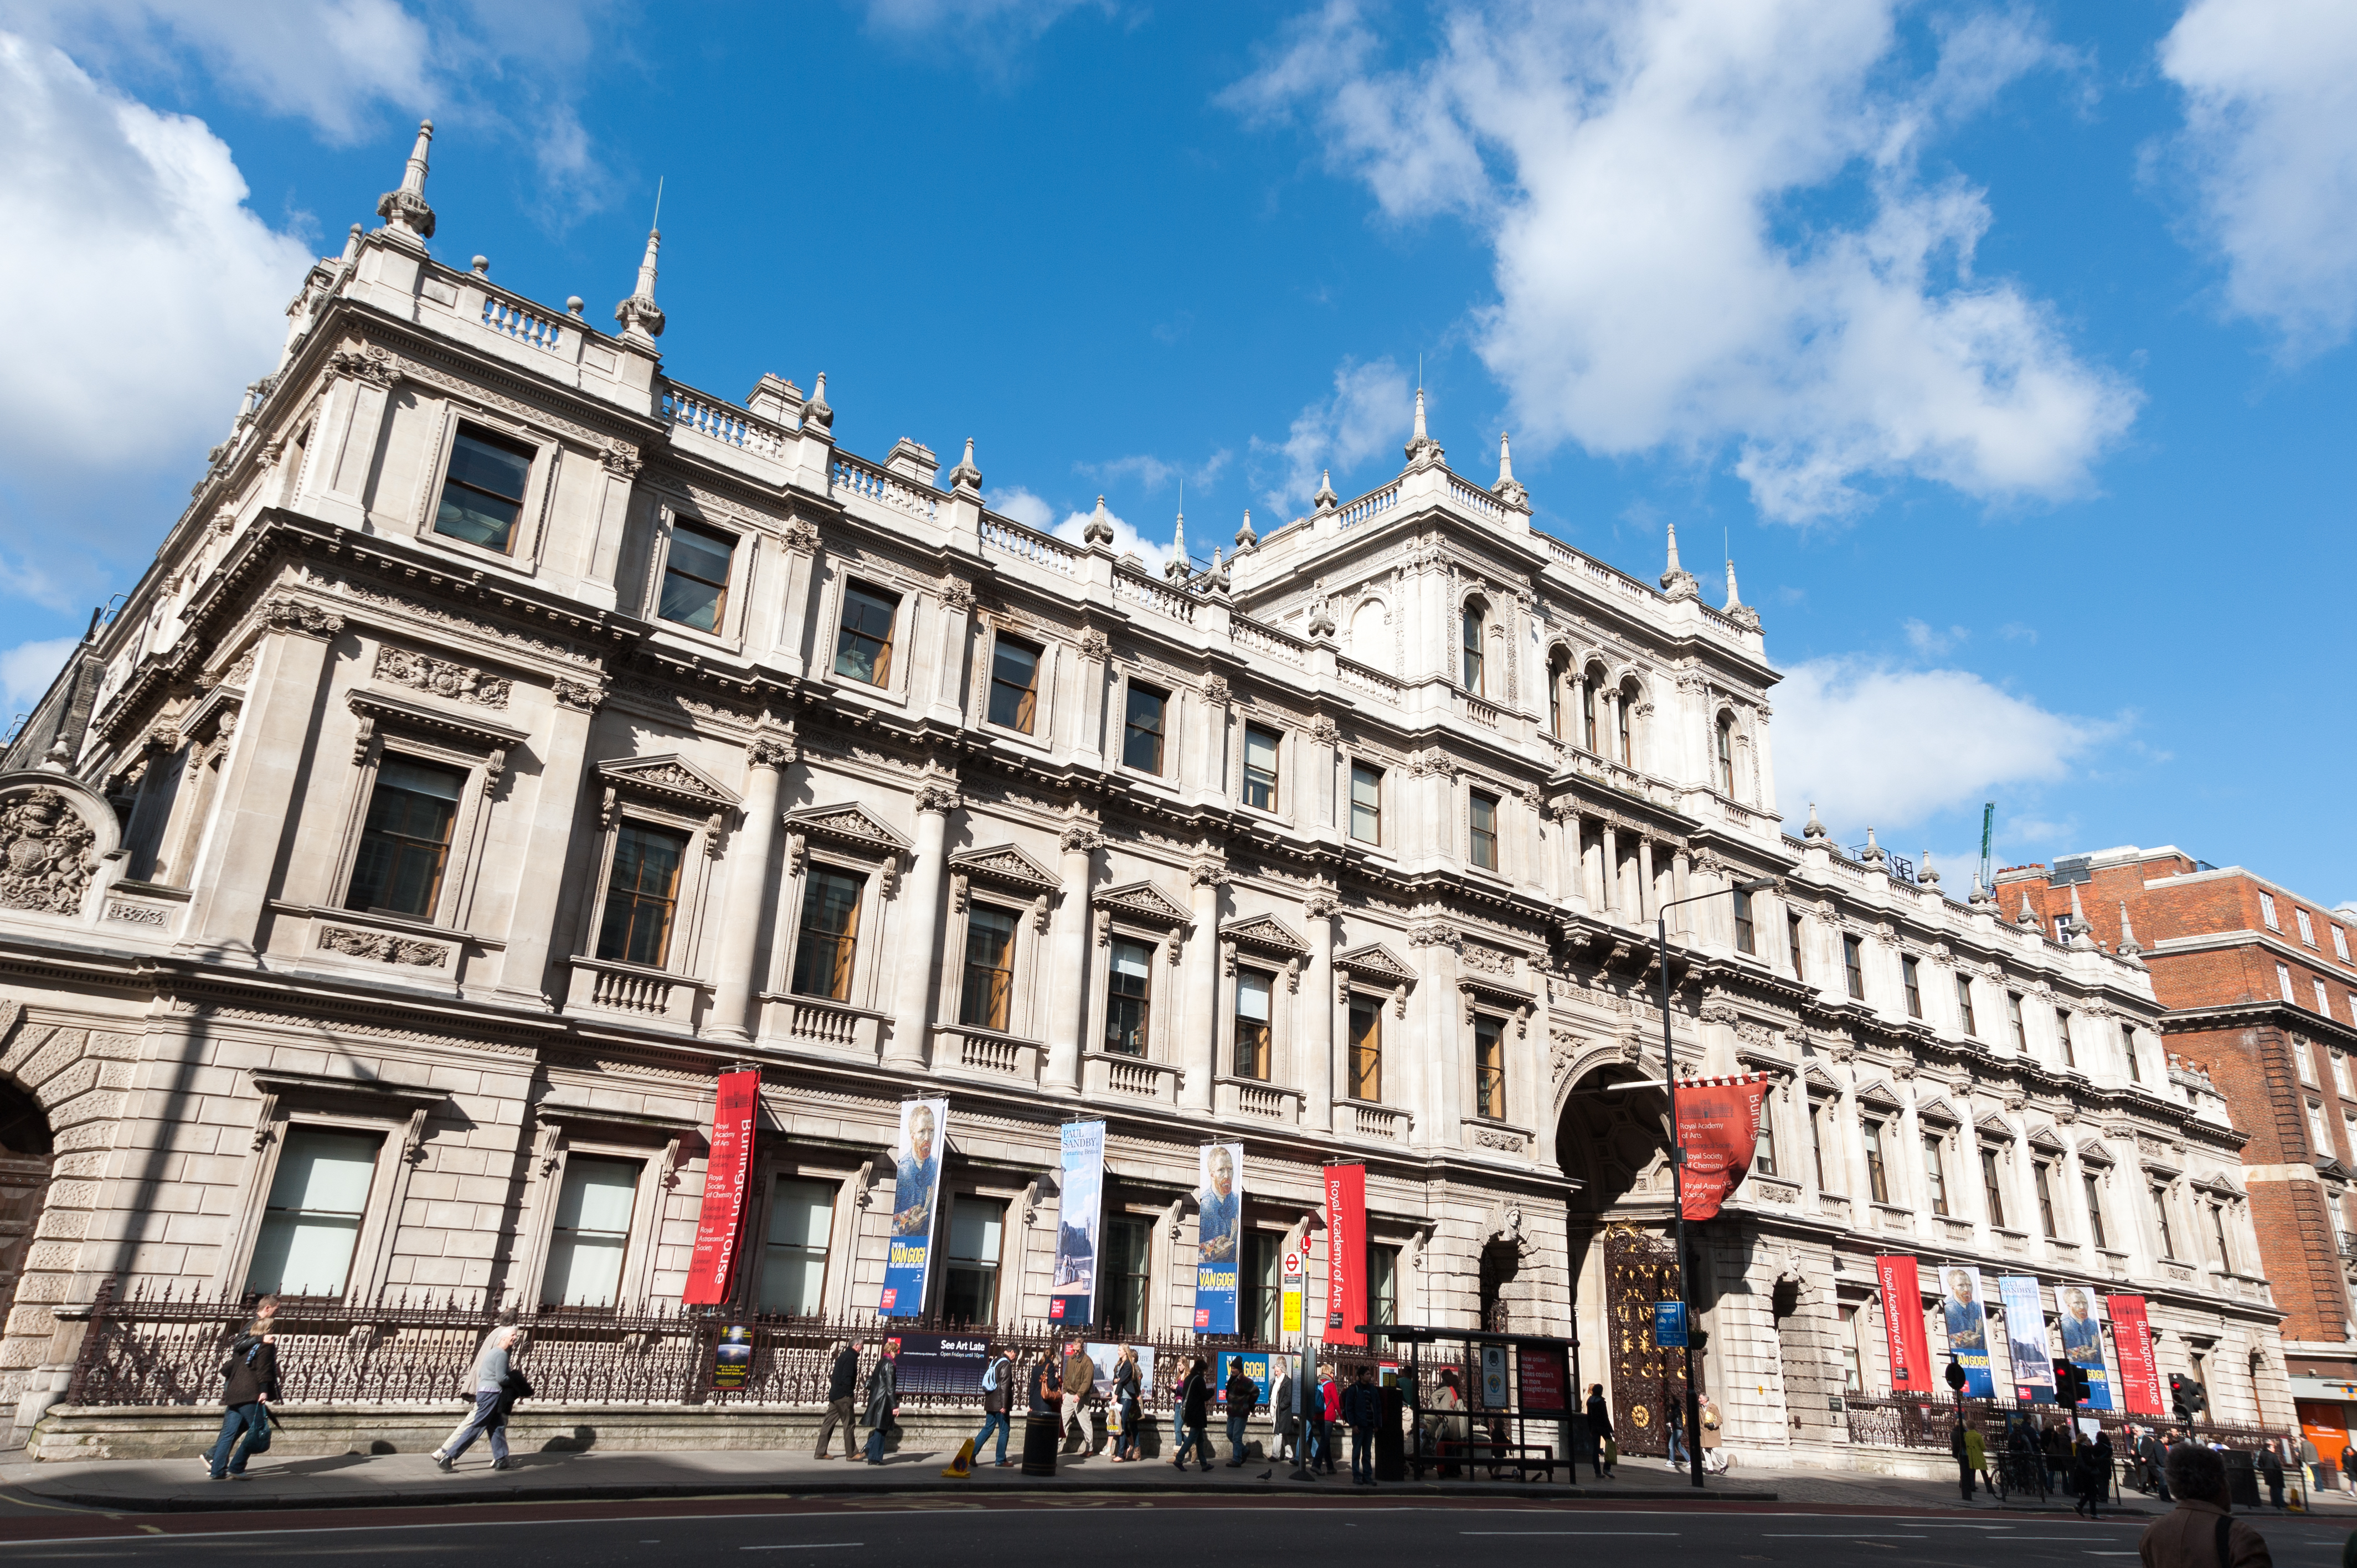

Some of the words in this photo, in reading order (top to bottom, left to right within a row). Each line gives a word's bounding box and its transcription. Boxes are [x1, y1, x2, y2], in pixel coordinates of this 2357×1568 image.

[1749, 1094, 1760, 1142] Burling
[1063, 1129, 1084, 1138] PAUL
[1680, 1123, 1696, 1131] Royal
[1698, 1122, 1723, 1130] Academy
[1063, 1138, 1096, 1148] SANDBY
[1716, 1142, 1734, 1150] Society
[1704, 1152, 1723, 1160] Society
[731, 1119, 752, 1216] Burlington
[1693, 1162, 1723, 1170] Chemistry
[1329, 1180, 1342, 1211] Royal
[1303, 1237, 1308, 1249] L
[1331, 1213, 1344, 1268] Academy
[714, 1222, 737, 1284] House
[891, 1247, 908, 1262] VAN
[1199, 1273, 1216, 1286] VAN
[1216, 1272, 1236, 1286] GOGH
[1333, 1268, 1344, 1283] of
[1883, 1267, 1896, 1290] Royal
[1333, 1283, 1344, 1308] Arts
[1887, 1292, 1900, 1334] Academy
[941, 1340, 955, 1349] See
[956, 1341, 968, 1350] Art
[970, 1342, 985, 1351] Late
[1893, 1335, 1903, 1345] of
[1895, 1347, 1903, 1365] Arts
[1958, 1355, 1969, 1365] AN
[1969, 1355, 1989, 1366] GOGH
[2137, 1321, 2154, 1371] Burlington
[2147, 1373, 2159, 1405] House
[1244, 1361, 1265, 1377] GOGH
[2087, 1369, 2106, 1379] GOGH
[1522, 1385, 1558, 1394] straightforward.
